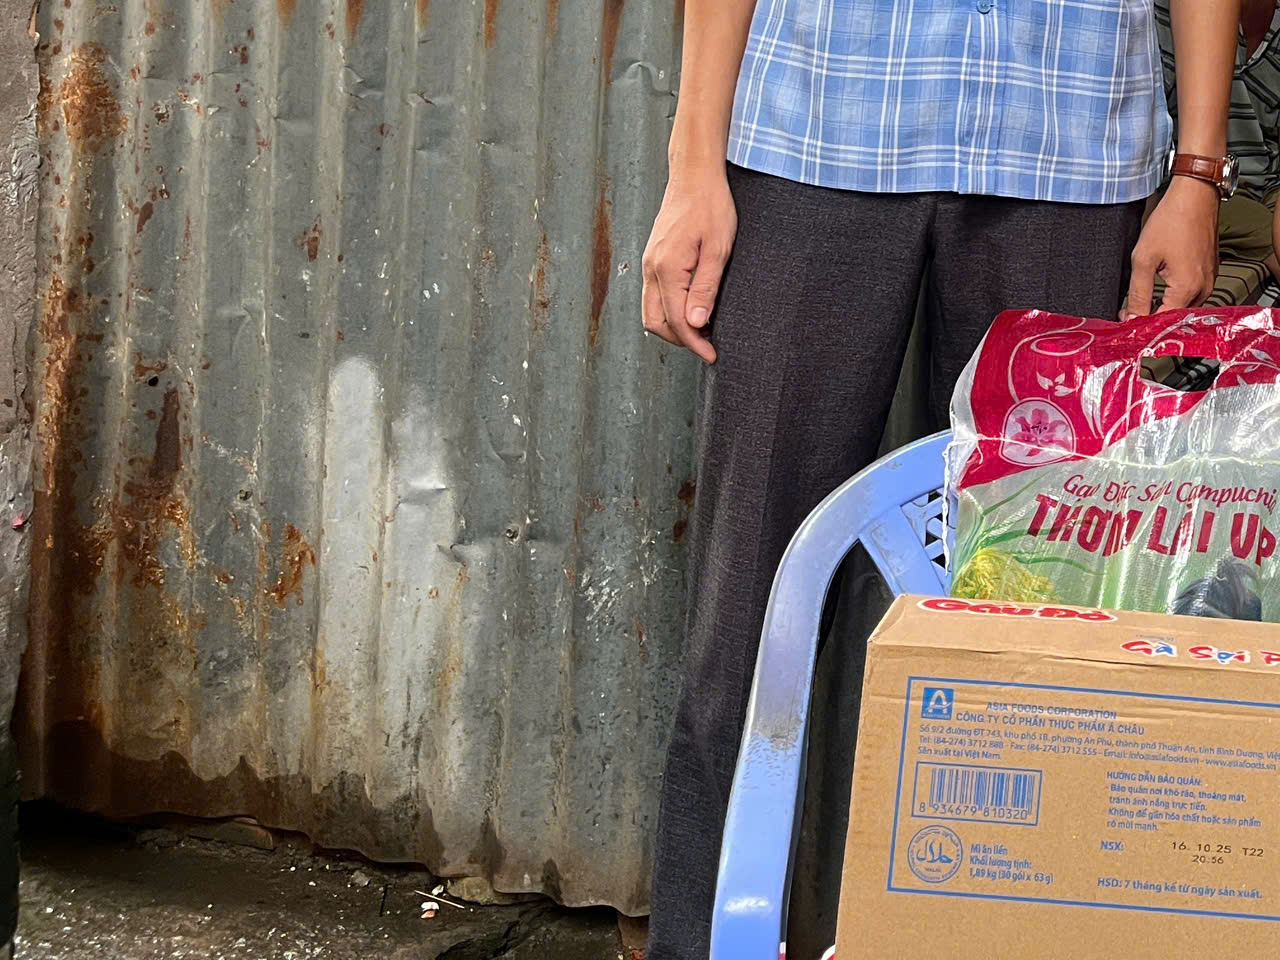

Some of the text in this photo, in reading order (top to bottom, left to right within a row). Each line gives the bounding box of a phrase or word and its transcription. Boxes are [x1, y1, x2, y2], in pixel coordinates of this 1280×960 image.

[1027, 493, 1143, 557] THƠM
[1231, 513, 1277, 567] UP
[1121, 640, 1177, 657] Gà
[1187, 645, 1250, 663] Sợi
[986, 702, 1117, 719] ASIA FOODS CORPORATION
[956, 711, 984, 723] CÔNG
[988, 715, 999, 724] TY
[1049, 718, 1074, 730] THỰC
[1117, 724, 1144, 735] CHÂU
[1004, 729, 1019, 739] khu
[1021, 730, 1036, 741] phố
[1163, 787, 1179, 797] khô
[1199, 790, 1226, 801] thoáng
[919, 802, 1028, 820] 8 934679 810320
[1109, 795, 1130, 804] tránh
[1132, 796, 1148, 806] ánh
[1149, 797, 1169, 809] nắng
[1172, 800, 1187, 811] trực
[1108, 807, 1134, 819] Không
[1136, 808, 1147, 818] để
[1148, 810, 1163, 820] gần
[1182, 812, 1200, 822] chất
[1202, 814, 1220, 824] hoặc
[1222, 816, 1237, 825] sản
[1238, 817, 1262, 828] phẩm
[971, 843, 981, 853] Mì
[982, 845, 992, 854] ăn
[1100, 840, 1124, 851] NSX:
[1198, 843, 1211, 852] 10
[1216, 845, 1232, 854] 25
[1242, 847, 1264, 857] T22
[969, 855, 1032, 869] Khối lượng tịnh:
[987, 870, 996, 880] kg
[1012, 871, 1025, 882] gói
[1034, 872, 1045, 881] 63
[1045, 873, 1054, 885] g)
[1097, 878, 1263, 899] HSD: 7 tháng kể từ ngày sản xuất.
